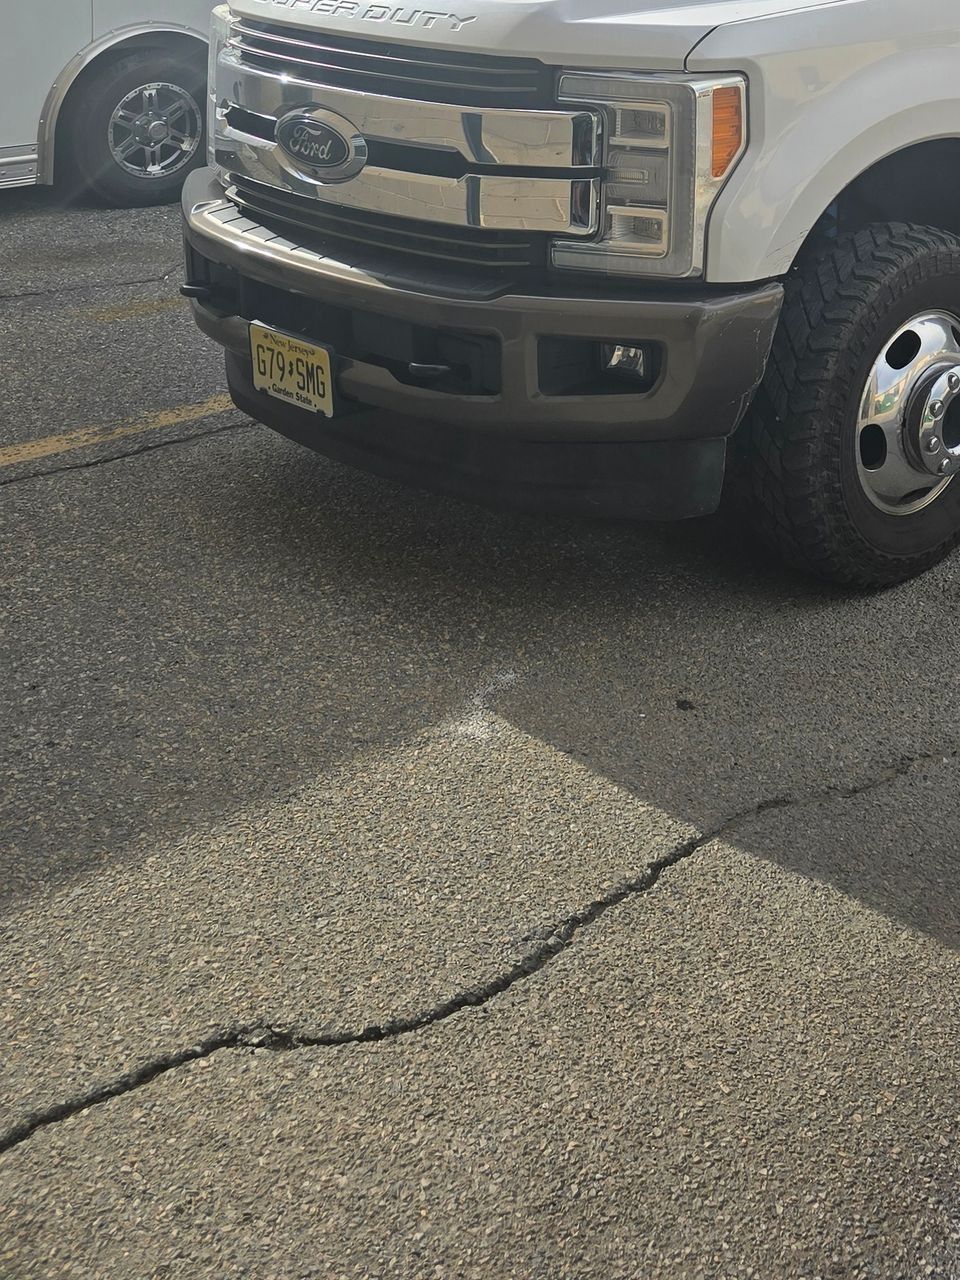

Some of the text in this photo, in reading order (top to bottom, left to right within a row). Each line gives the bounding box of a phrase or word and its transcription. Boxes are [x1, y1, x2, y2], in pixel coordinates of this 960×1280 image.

[361, 4, 478, 32] DUTY
[289, 124, 333, 160] Ford
[269, 333, 310, 358] New Jersey
[271, 383, 313, 406] Garden State
